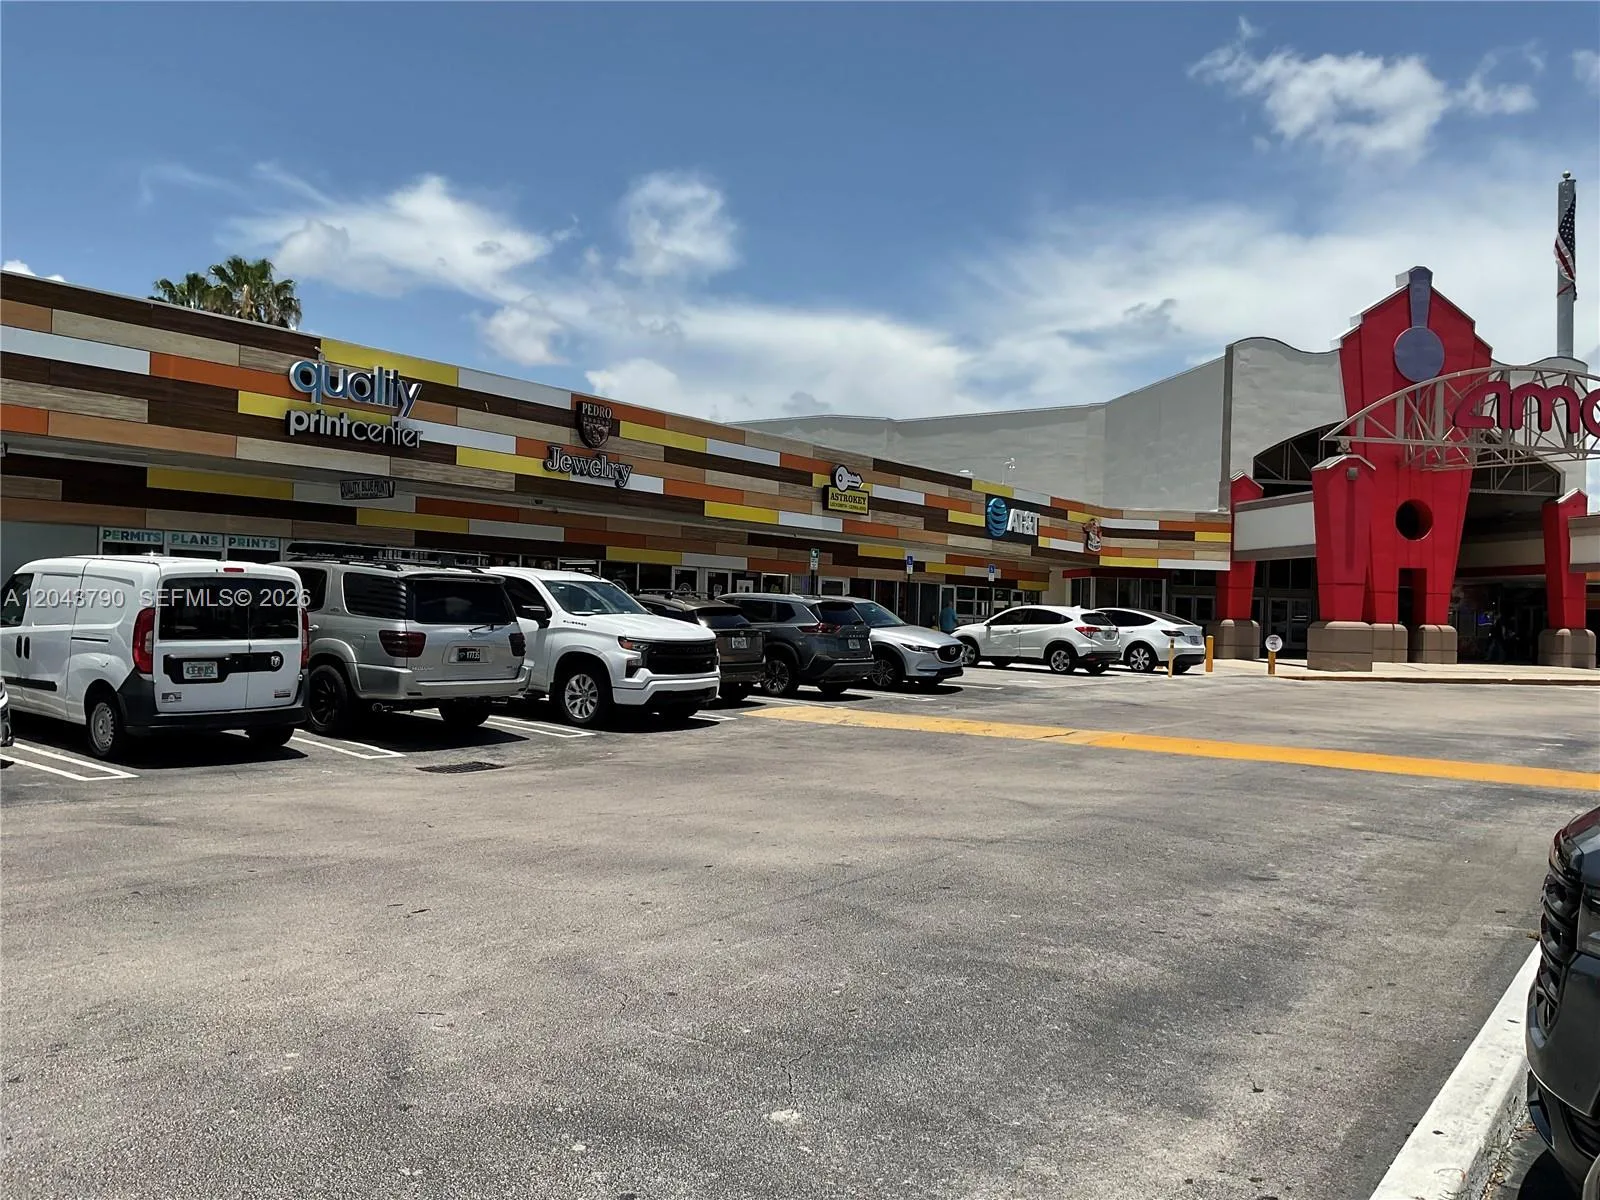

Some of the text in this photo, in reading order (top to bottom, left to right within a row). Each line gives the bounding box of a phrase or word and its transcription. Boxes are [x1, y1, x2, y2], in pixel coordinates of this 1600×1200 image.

[289, 360, 422, 418] quality
[582, 402, 612, 419] PEDRO
[545, 446, 633, 487] Jewelry
[831, 492, 867, 505] ASTROKEY
[1006, 508, 1040, 536] AT&T
[103, 529, 277, 549] PERMITS PLANS PRINTS
